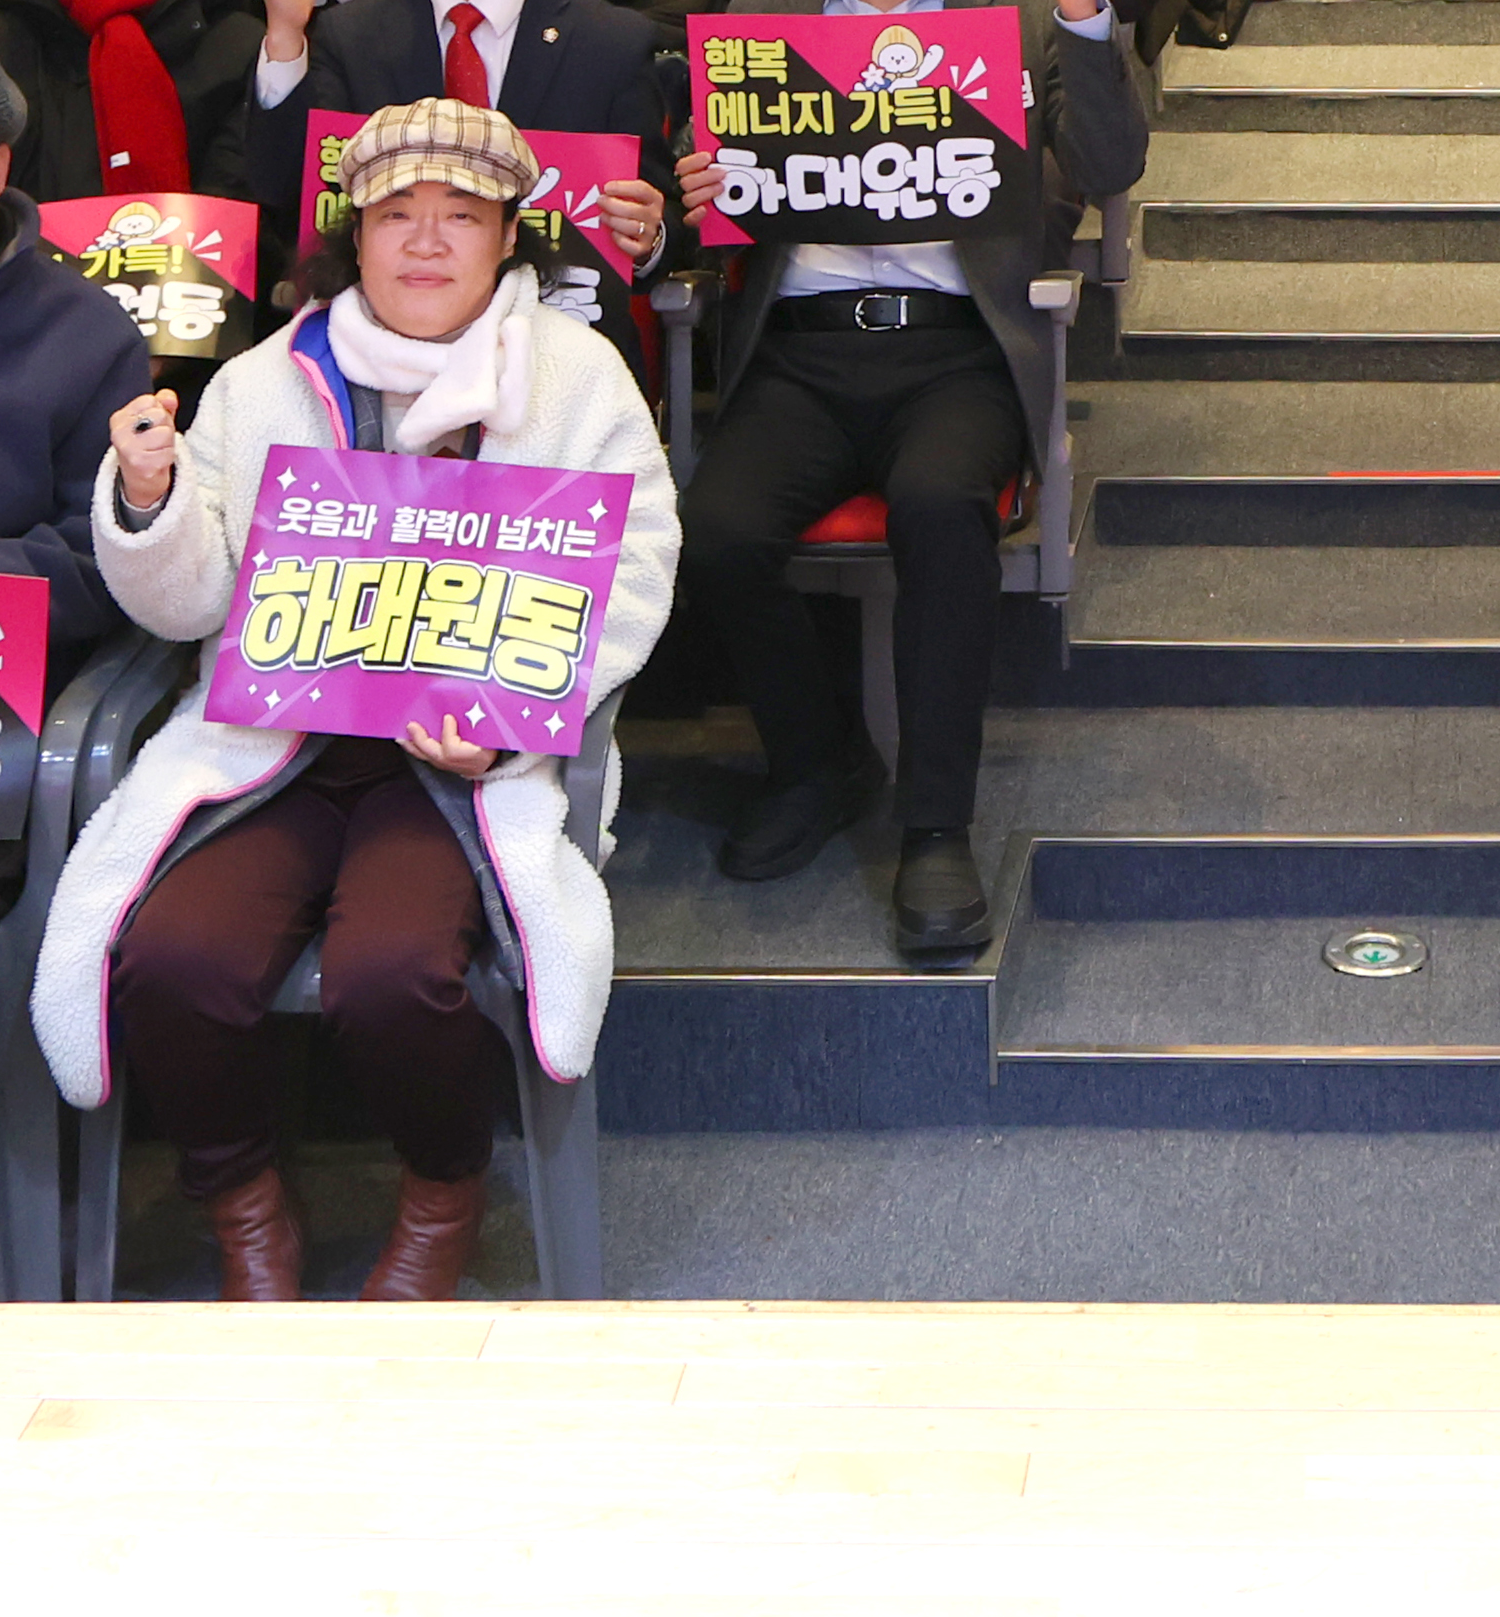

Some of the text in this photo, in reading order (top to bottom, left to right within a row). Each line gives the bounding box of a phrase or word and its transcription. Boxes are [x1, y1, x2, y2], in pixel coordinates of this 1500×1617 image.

[703, 36, 788, 85] 행복
[705, 84, 953, 138] 에너지 가득!
[712, 136, 1002, 221] 하대원동
[274, 496, 600, 560] 웃음과 활력이 넘치는
[238, 554, 592, 701] 하대원동
